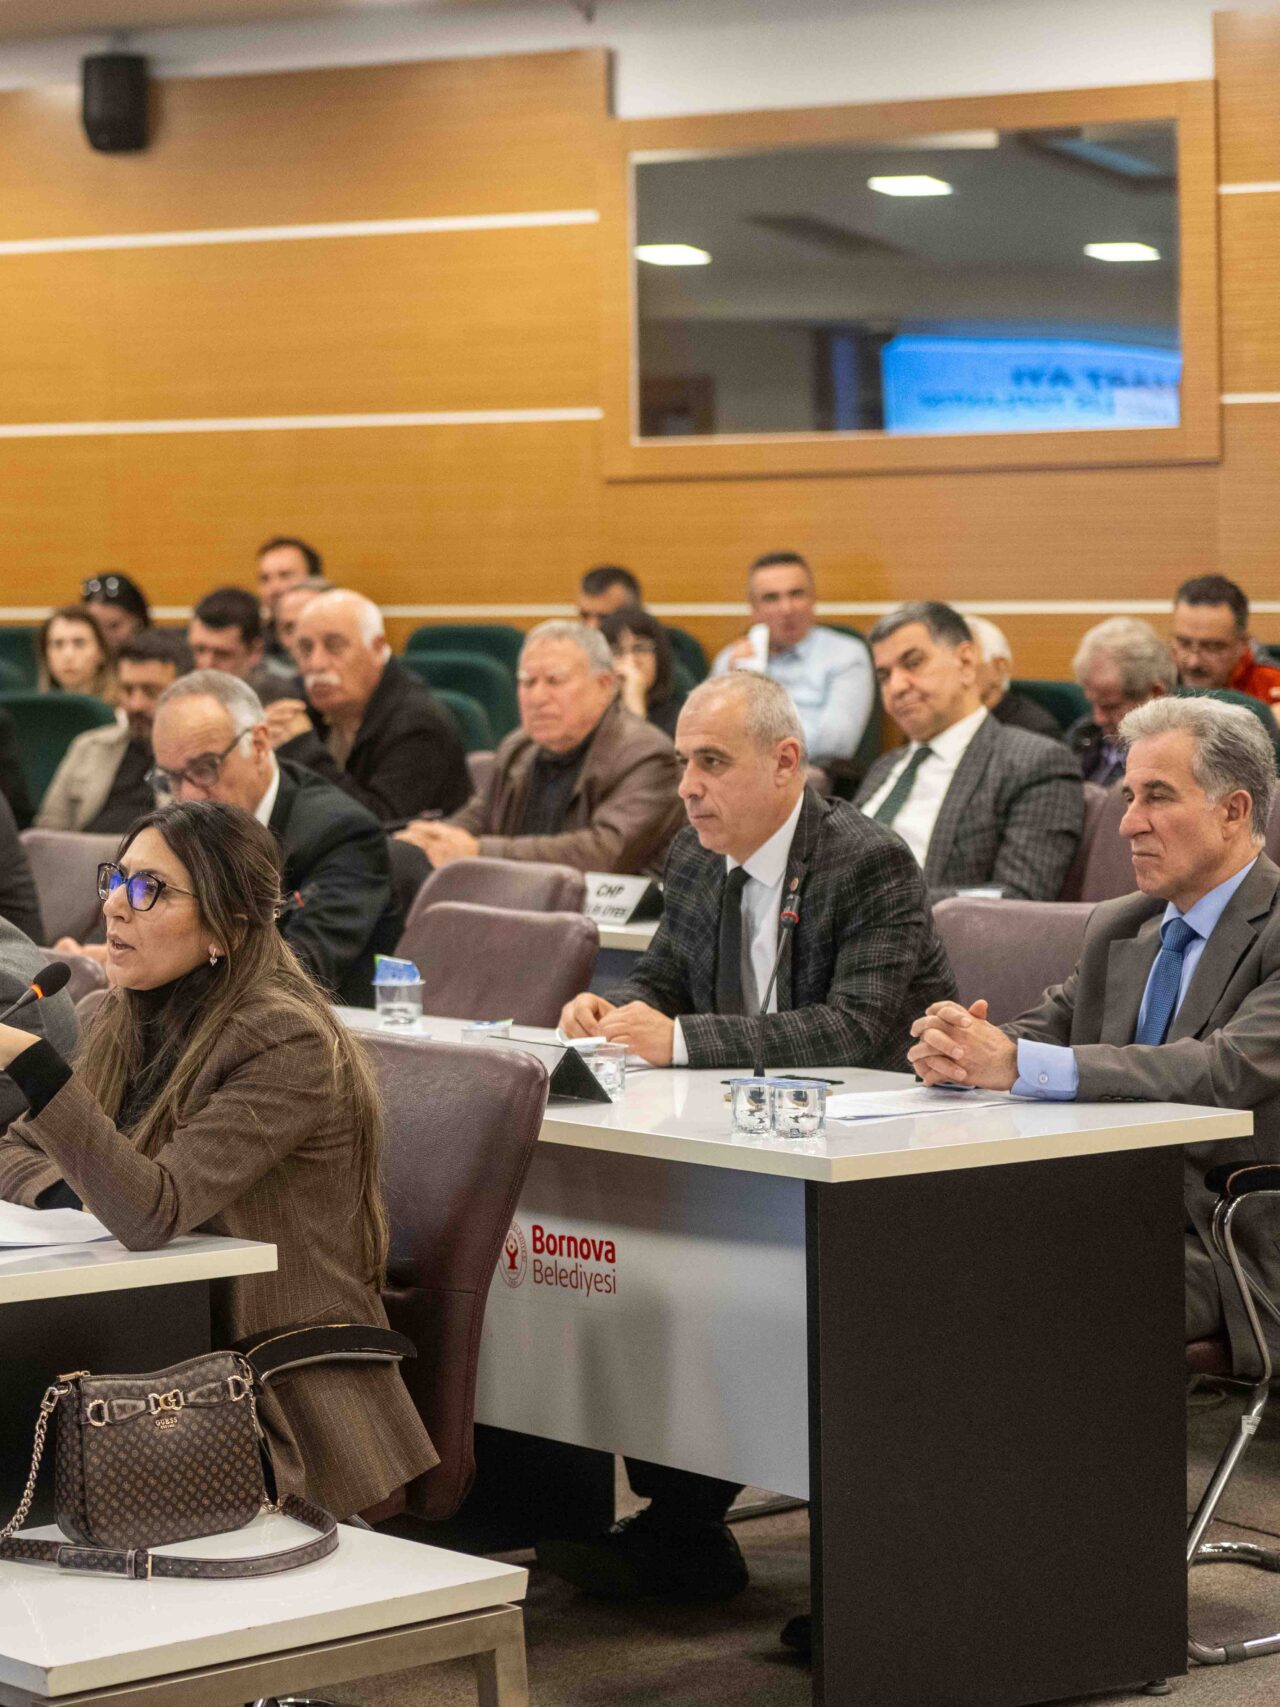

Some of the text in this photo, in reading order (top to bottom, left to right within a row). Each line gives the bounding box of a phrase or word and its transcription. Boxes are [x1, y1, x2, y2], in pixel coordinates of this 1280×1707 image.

[532, 1224, 616, 1263] Bornova
[533, 1259, 616, 1297] Belediyesi
[155, 1416, 178, 1426] GUESS
